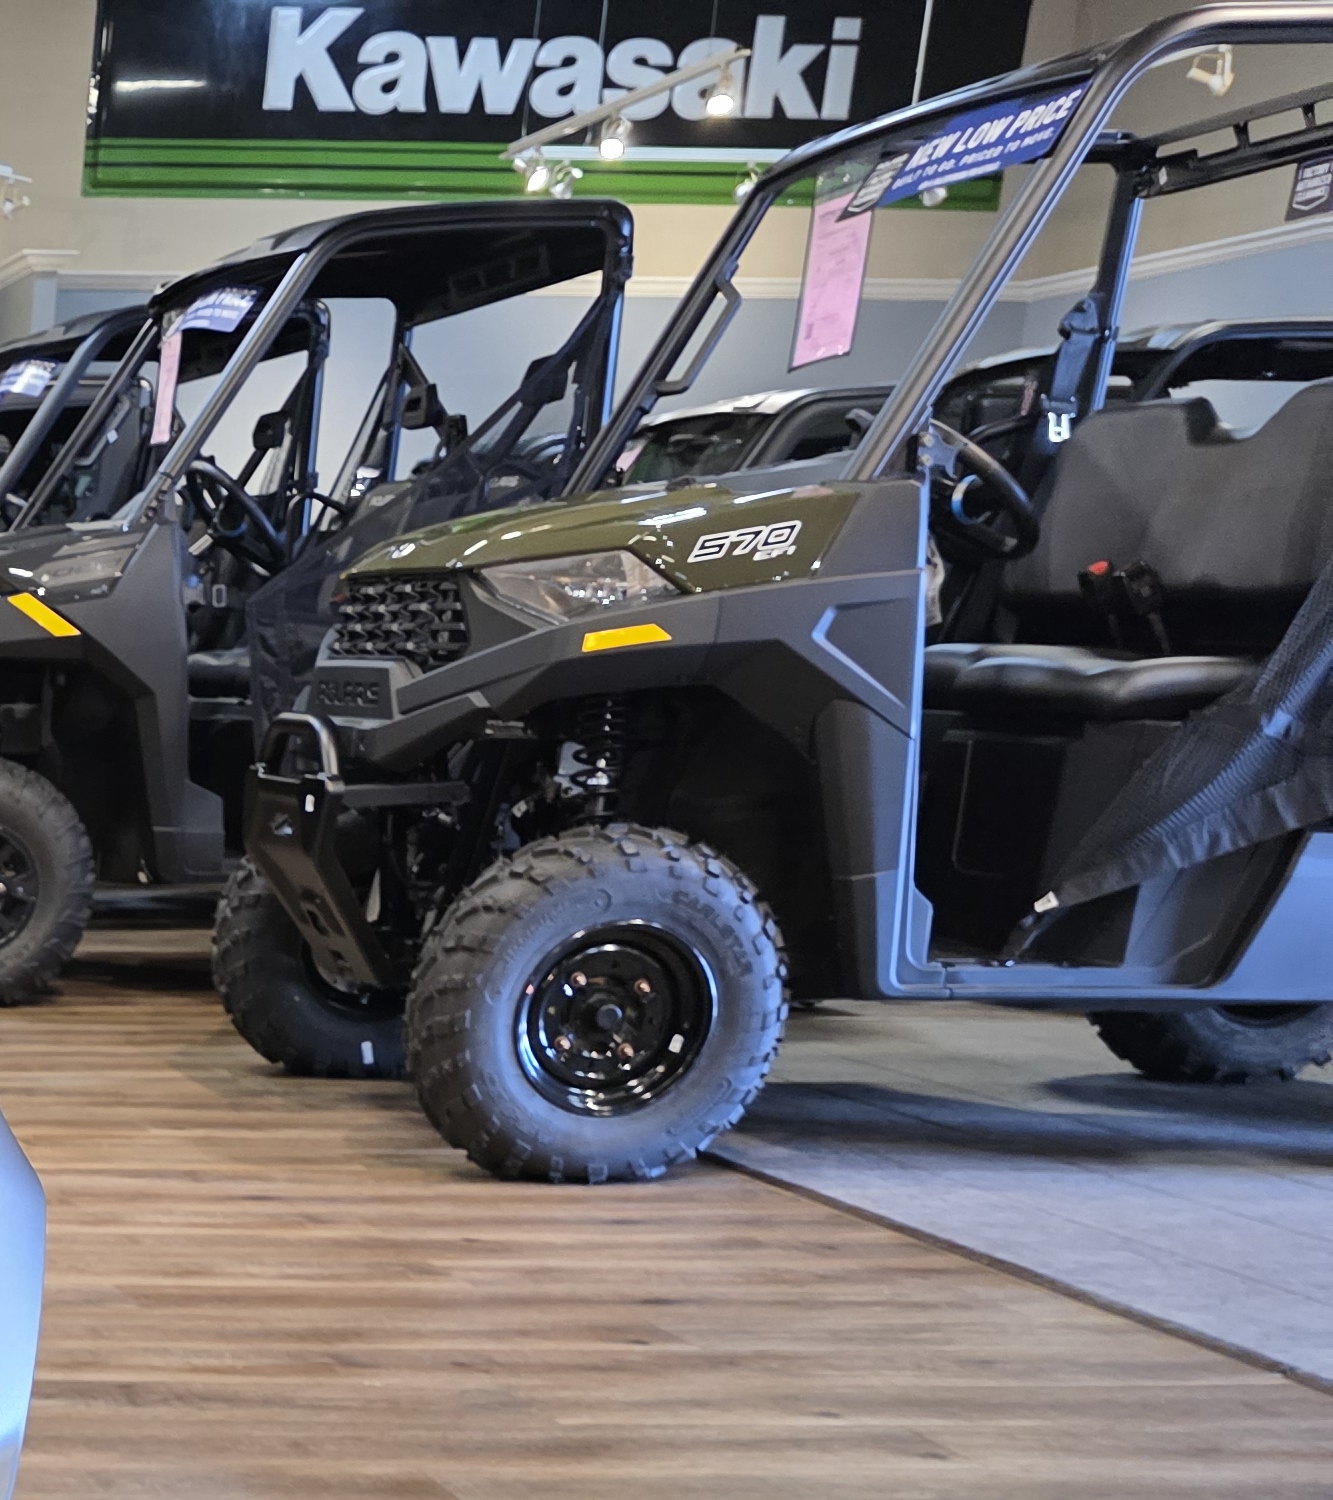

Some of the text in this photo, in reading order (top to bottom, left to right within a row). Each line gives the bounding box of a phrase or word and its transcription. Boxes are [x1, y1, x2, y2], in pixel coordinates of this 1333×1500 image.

[263, 7, 862, 121] Kawasaki
[905, 88, 1082, 172] NEW LOW PRICE
[1004, 139, 1021, 154] TO
[686, 519, 802, 563] 570
